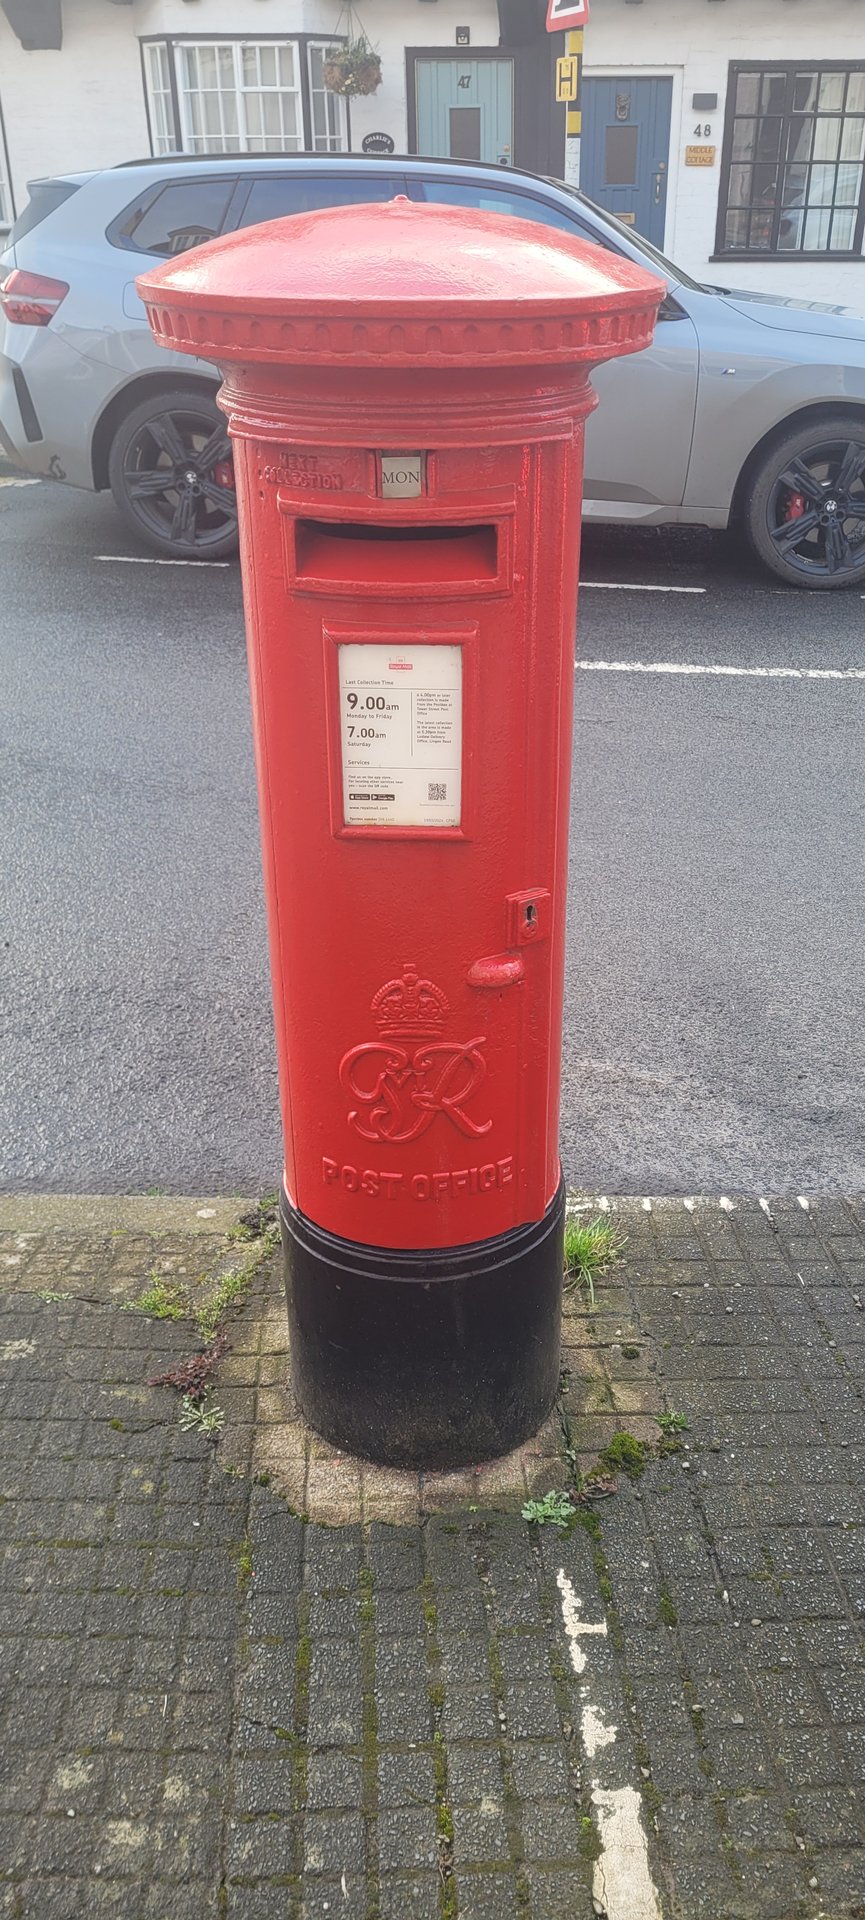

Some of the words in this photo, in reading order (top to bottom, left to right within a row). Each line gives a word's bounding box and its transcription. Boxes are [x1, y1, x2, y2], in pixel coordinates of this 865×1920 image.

[457, 75, 471, 89] 47
[693, 123, 711, 137] 48
[280, 451, 319, 471] NEXT
[264, 465, 343, 490] COLLECTION
[382, 471, 420, 484] MON
[346, 693, 400, 711] 9.00am
[347, 726, 386, 739] 7.00am
[322, 1156, 404, 1200] POST
[411, 1155, 513, 1201] OFFICE
